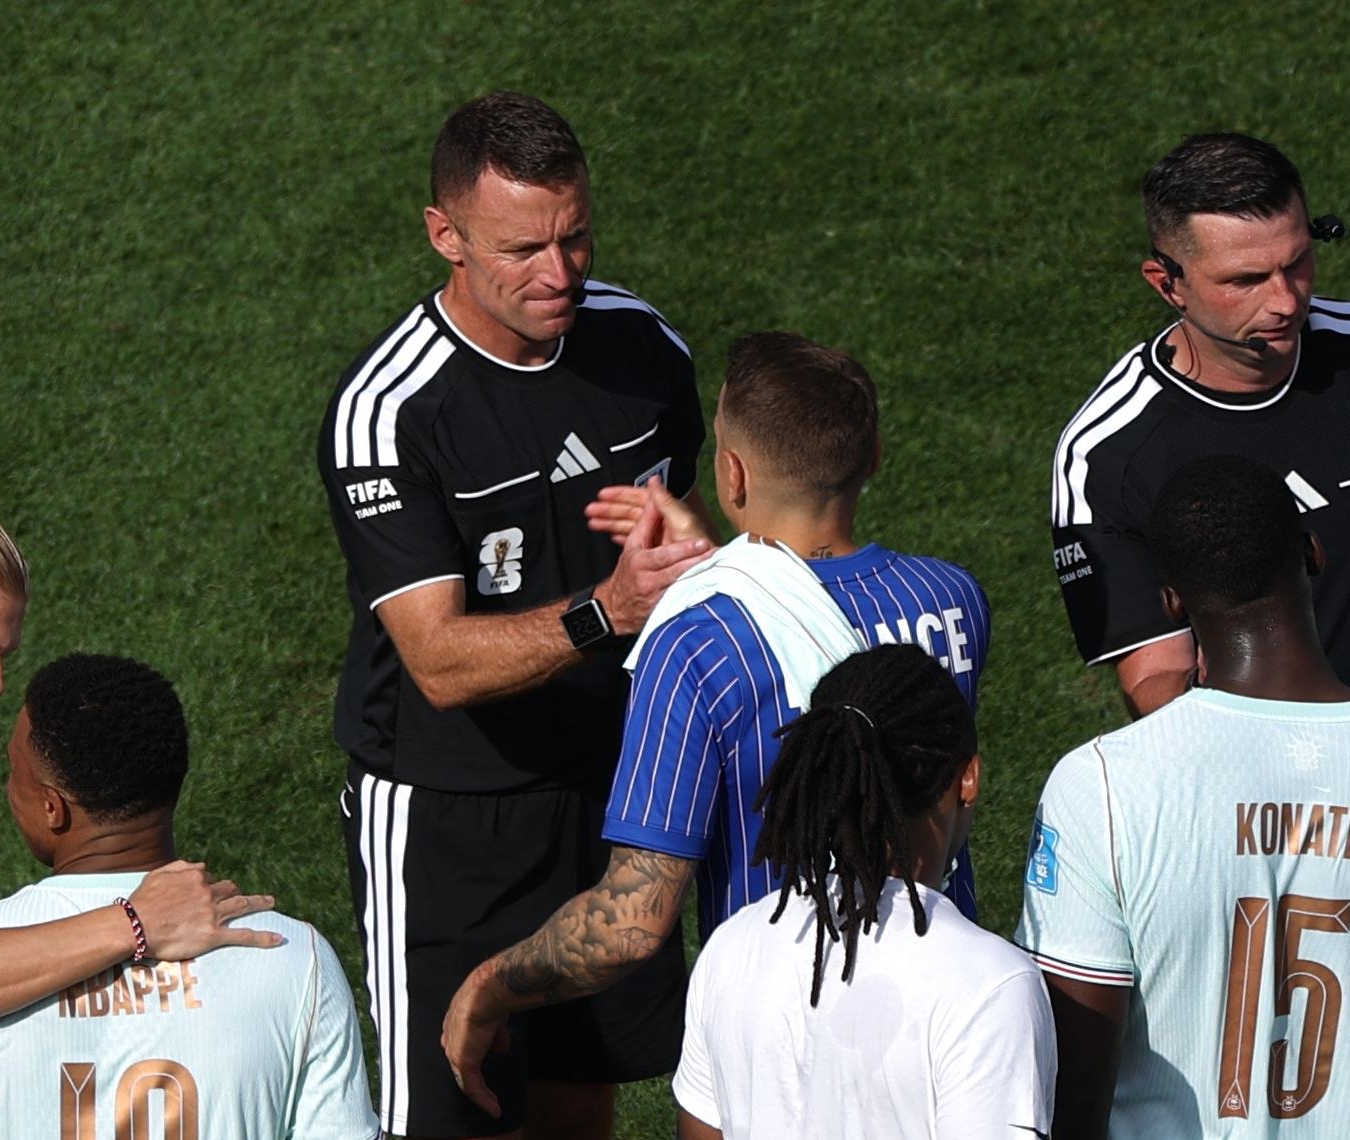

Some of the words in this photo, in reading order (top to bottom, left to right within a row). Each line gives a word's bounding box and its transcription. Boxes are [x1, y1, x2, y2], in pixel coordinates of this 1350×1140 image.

[346, 478, 398, 504] FIFA
[378, 500, 403, 513] ONE
[1053, 541, 1087, 570] FIFA
[1076, 565, 1093, 579] ONE
